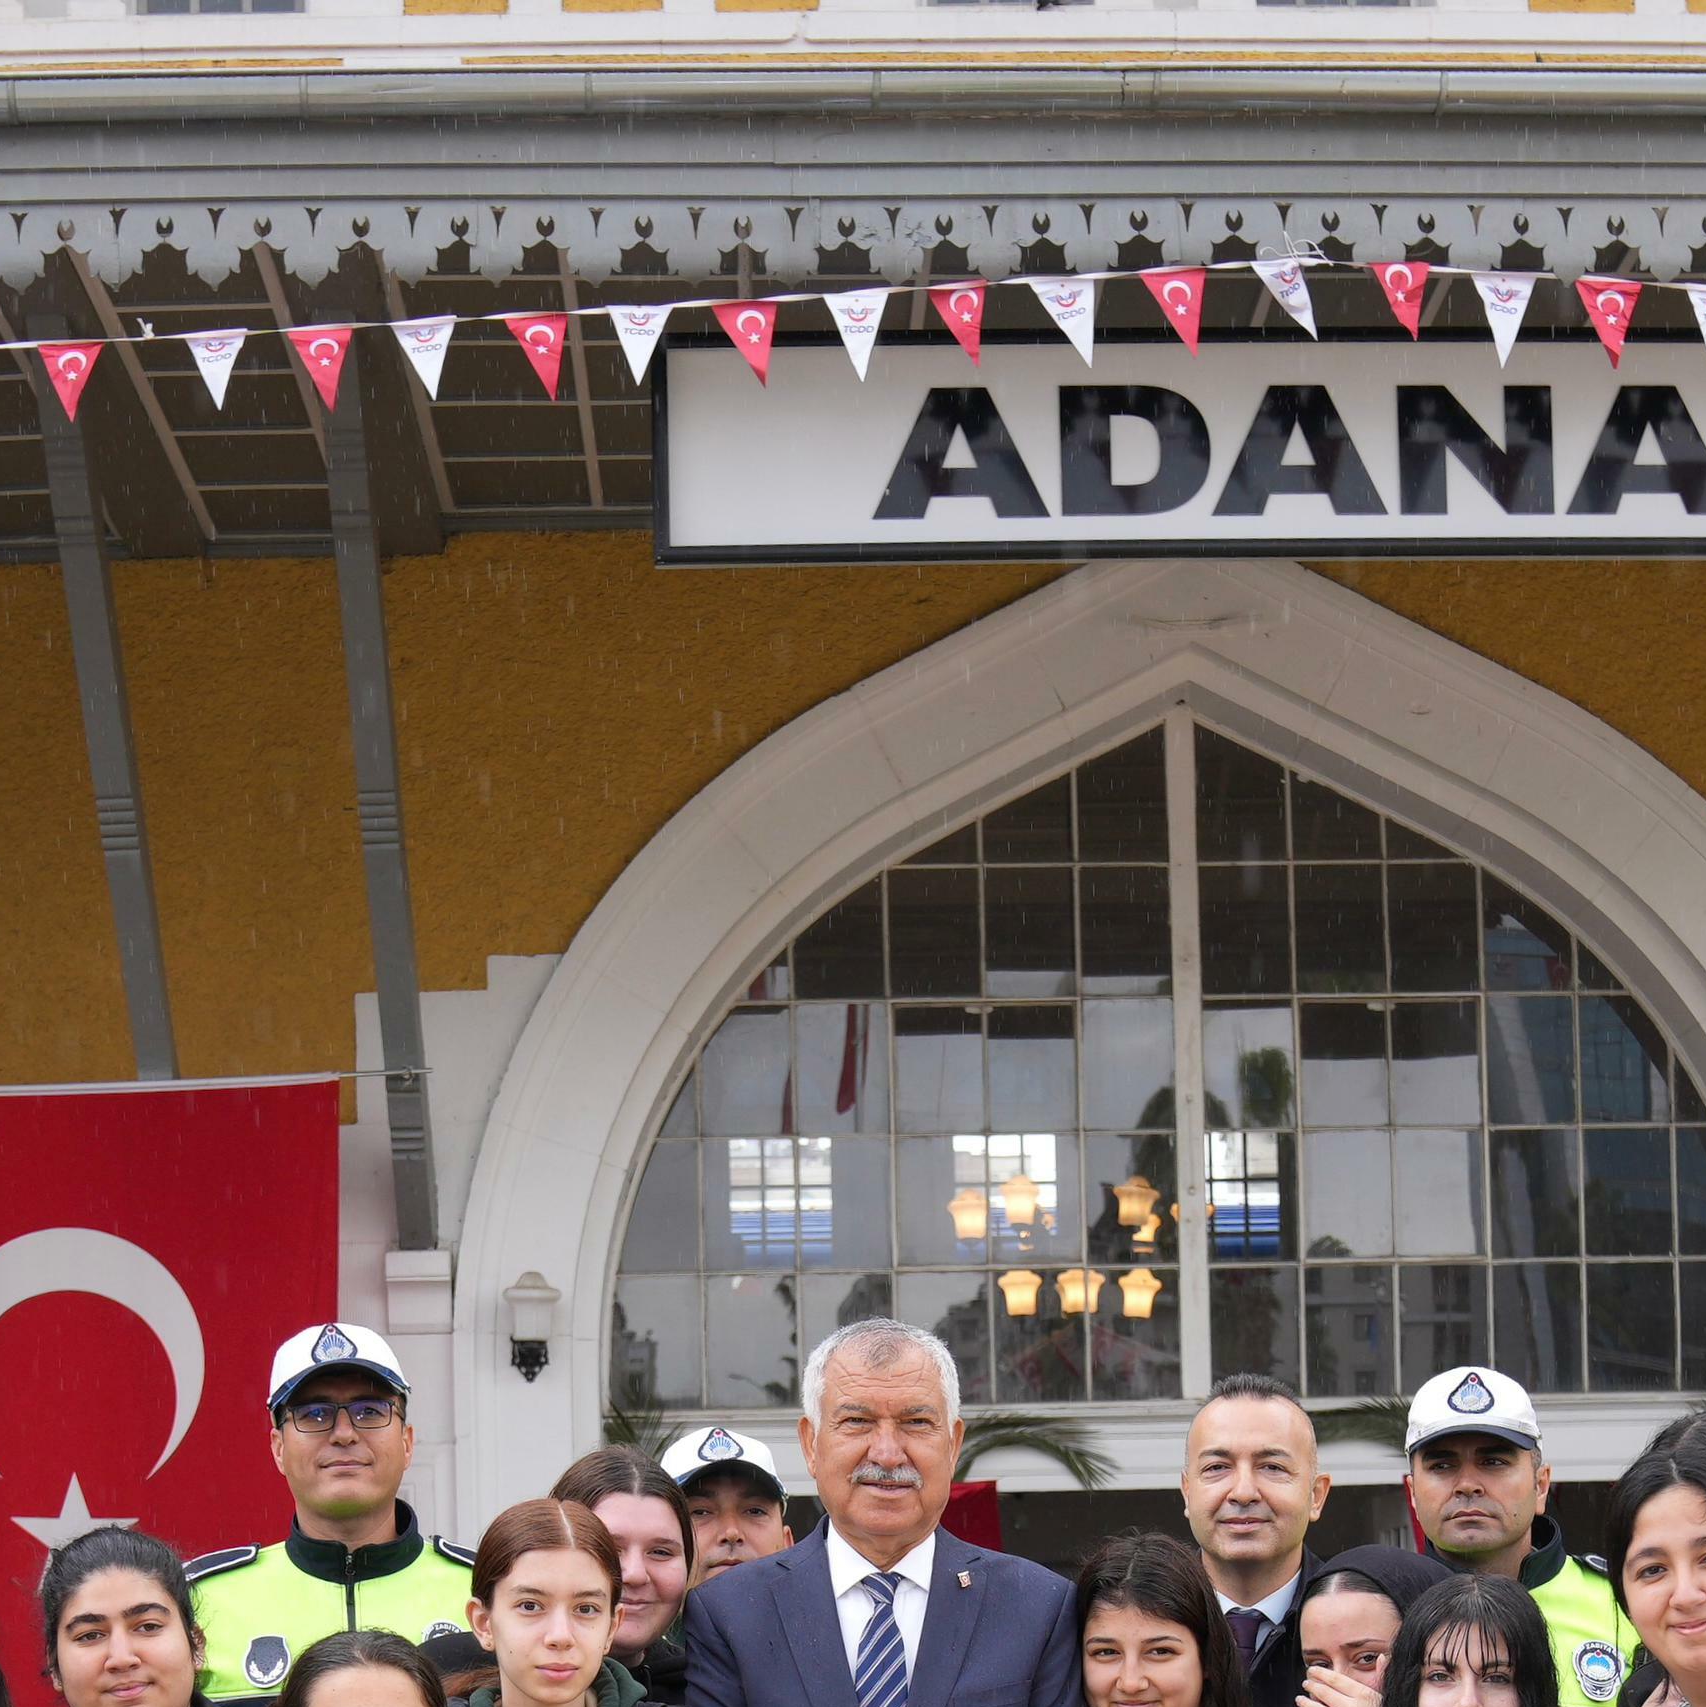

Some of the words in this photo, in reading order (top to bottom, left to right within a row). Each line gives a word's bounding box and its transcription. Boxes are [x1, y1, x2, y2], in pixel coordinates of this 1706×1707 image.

[1490, 303, 1517, 314] TCDD
[1056, 308, 1086, 320] TCDD
[624, 328, 655, 336] TCDD
[411, 344, 442, 353] TCDD
[201, 353, 231, 363] TCDD
